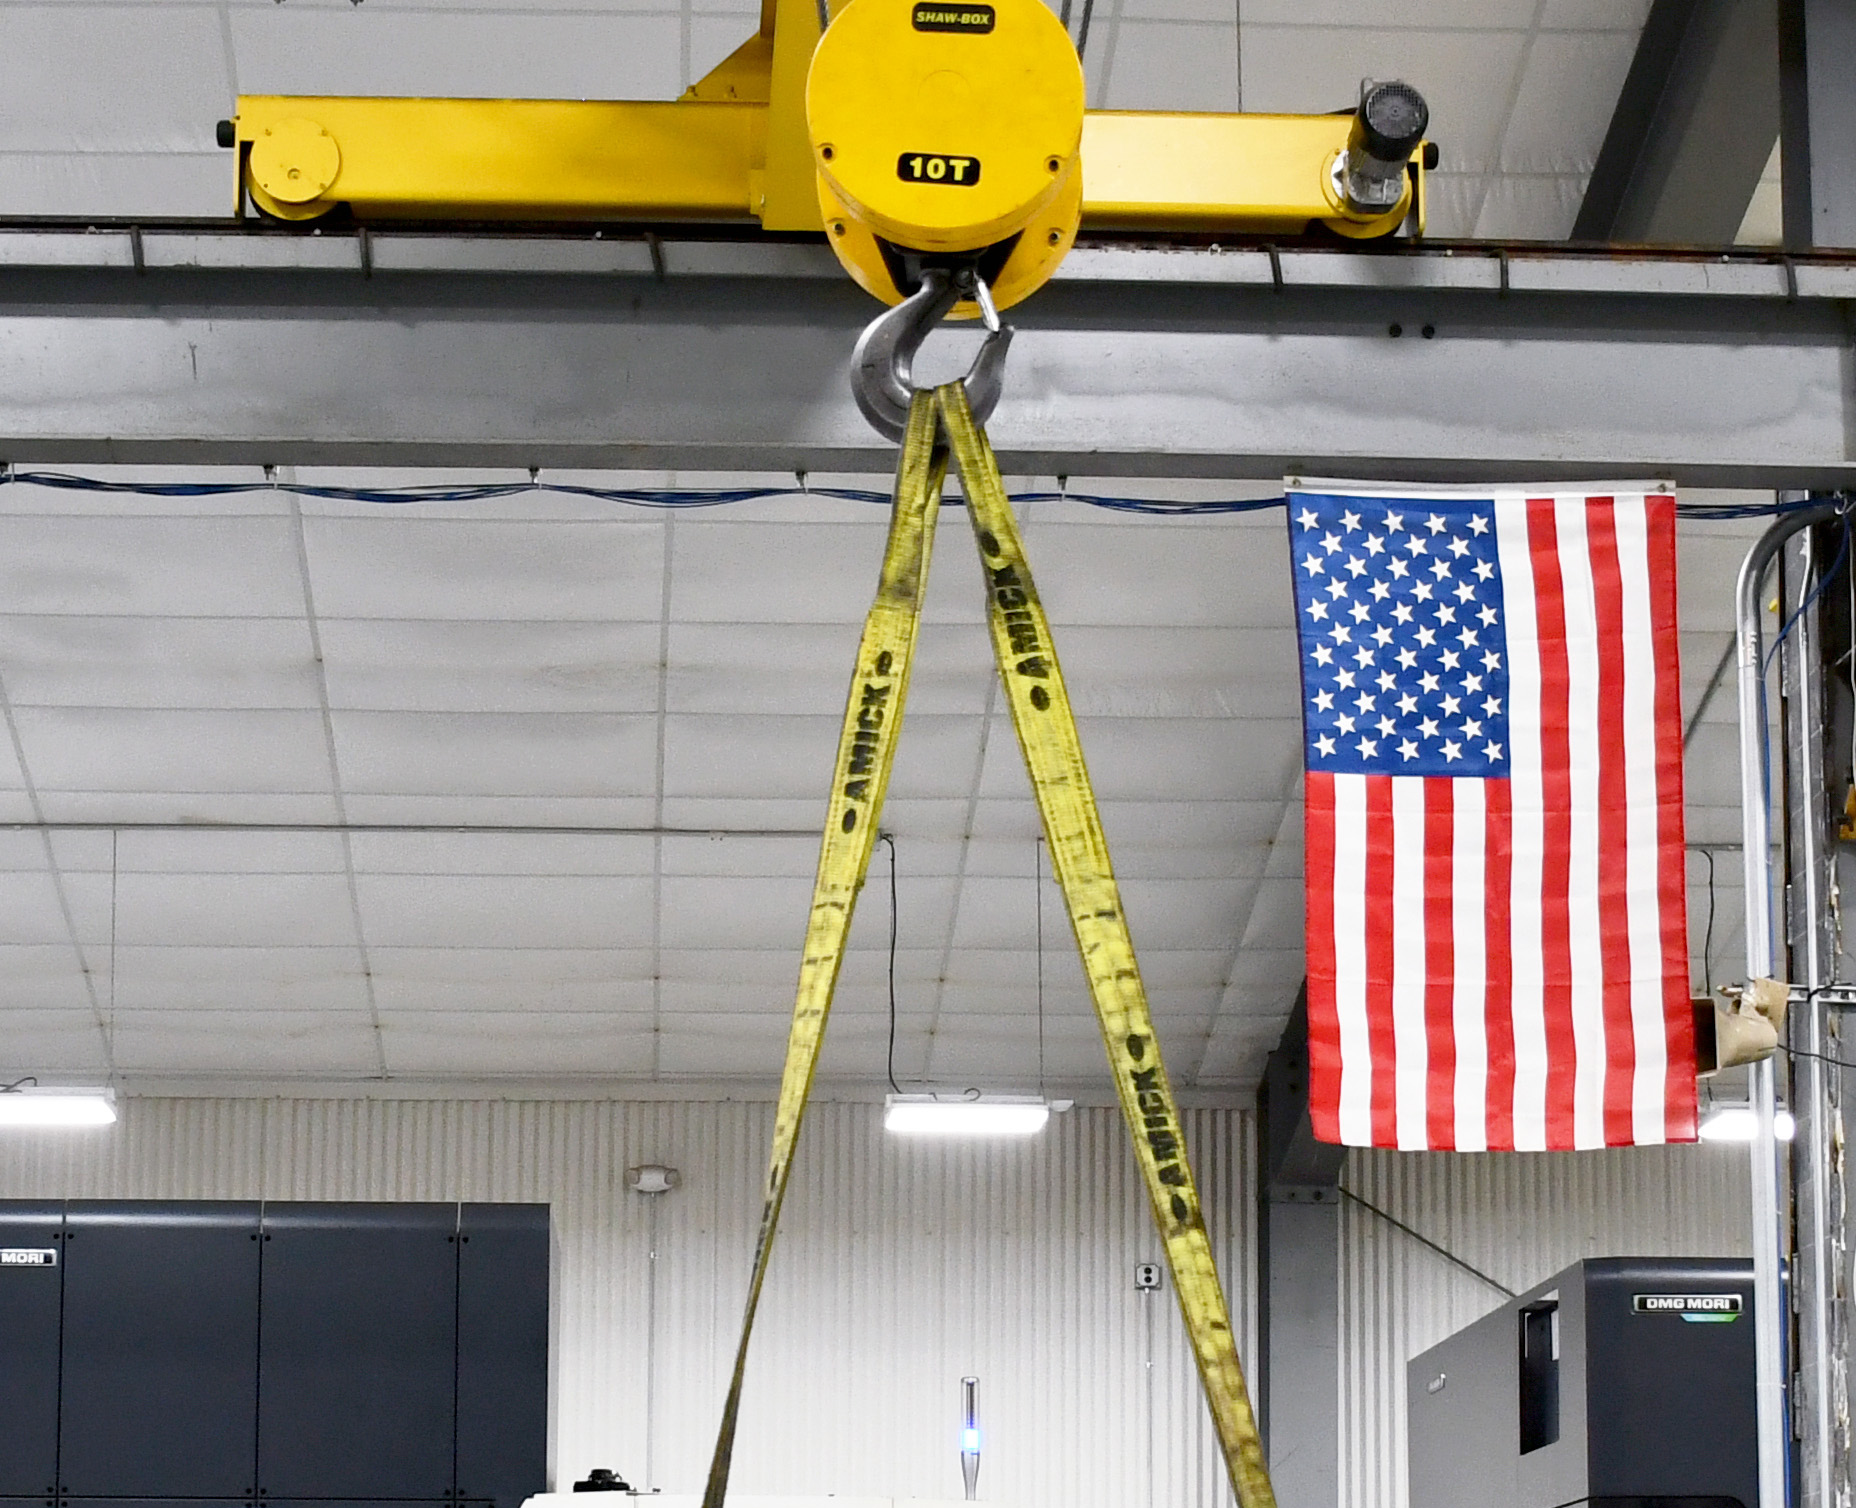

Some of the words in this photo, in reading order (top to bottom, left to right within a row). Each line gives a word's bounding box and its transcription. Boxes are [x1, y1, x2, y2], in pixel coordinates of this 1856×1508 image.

[916, 12, 990, 25] SHAW-BOX
[909, 157, 970, 181] 10T
[989, 566, 1052, 680] AMICK
[844, 683, 891, 802] AMICK
[1129, 1067, 1187, 1187] AMICK
[1, 1253, 44, 1264] MORI
[1646, 1298, 1684, 1309] DMG
[1687, 1298, 1730, 1310] MORI
